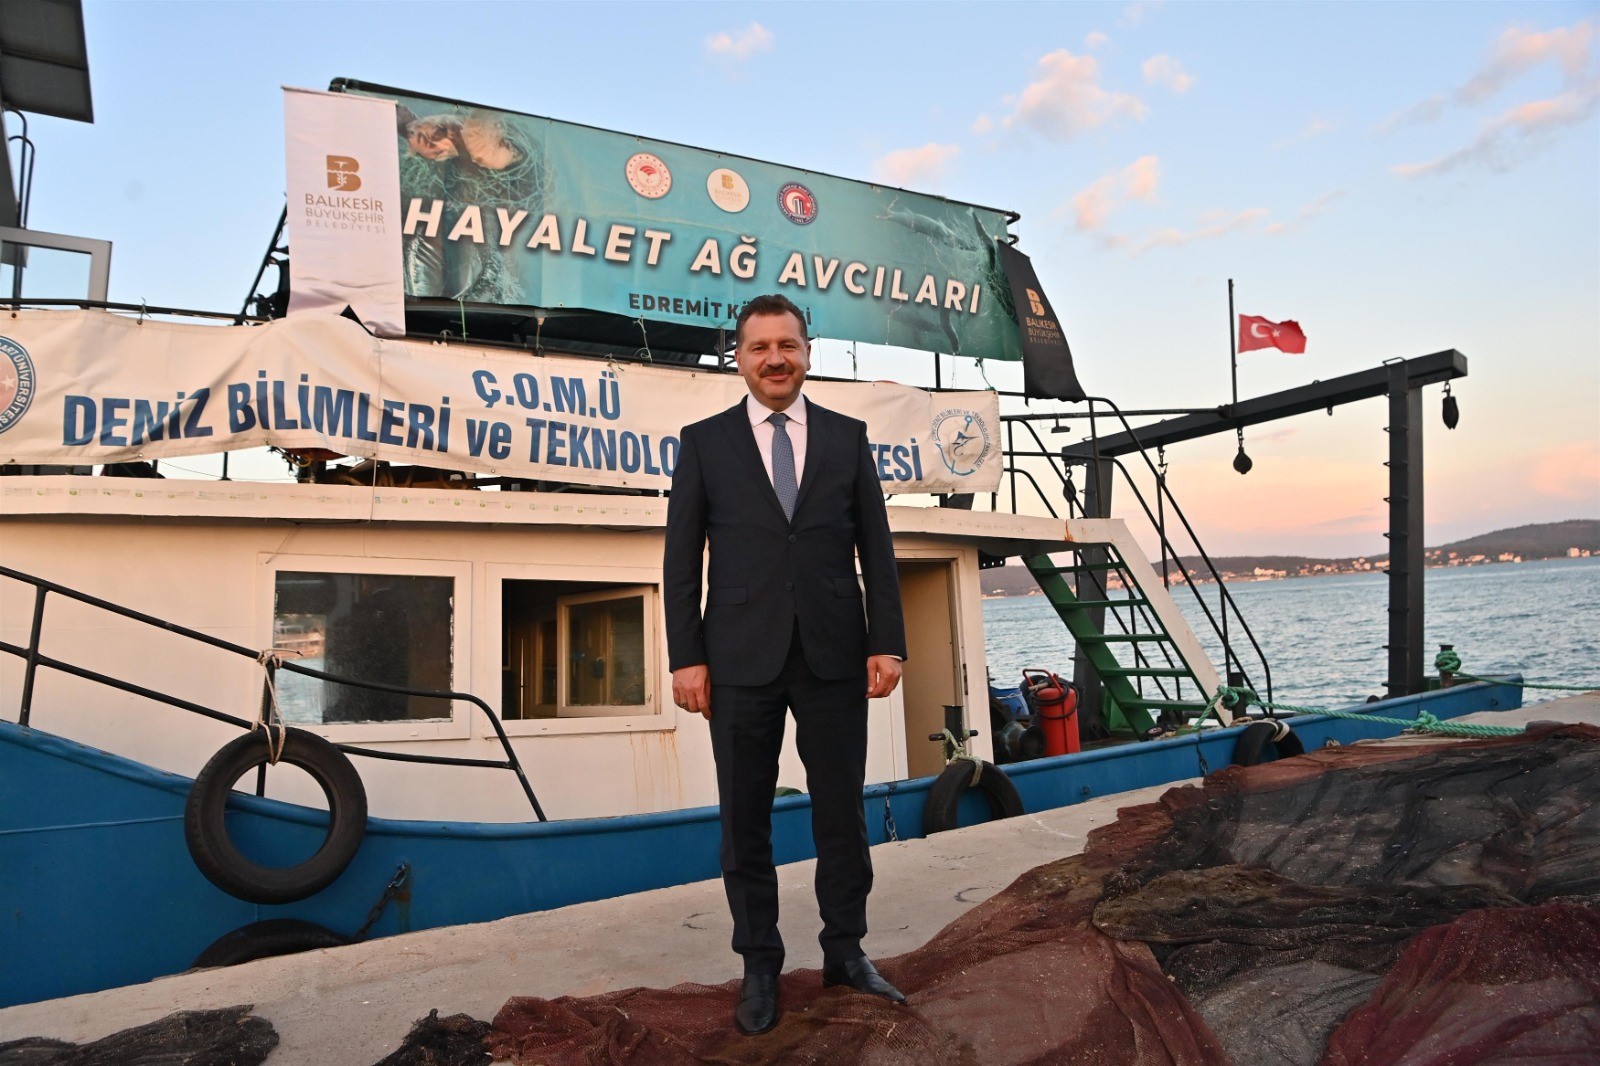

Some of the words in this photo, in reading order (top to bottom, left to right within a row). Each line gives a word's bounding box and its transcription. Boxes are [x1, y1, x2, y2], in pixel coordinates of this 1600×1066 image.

[305, 193, 384, 213] BALIKESİR
[305, 207, 385, 226] BÜYÜKŞEHİR
[403, 197, 672, 266] HAYALET
[690, 234, 758, 279] AĞ
[778, 252, 981, 315] AVCILARI
[628, 293, 723, 319] EDREMİT
[0, 342, 19, 355] ART
[471, 369, 621, 421] Ç.O.M.Ü
[62, 387, 213, 447] DENİZ
[227, 370, 451, 453] BİLİMLERİ
[465, 418, 512, 460] ve
[526, 417, 680, 478] TEKNOLO
